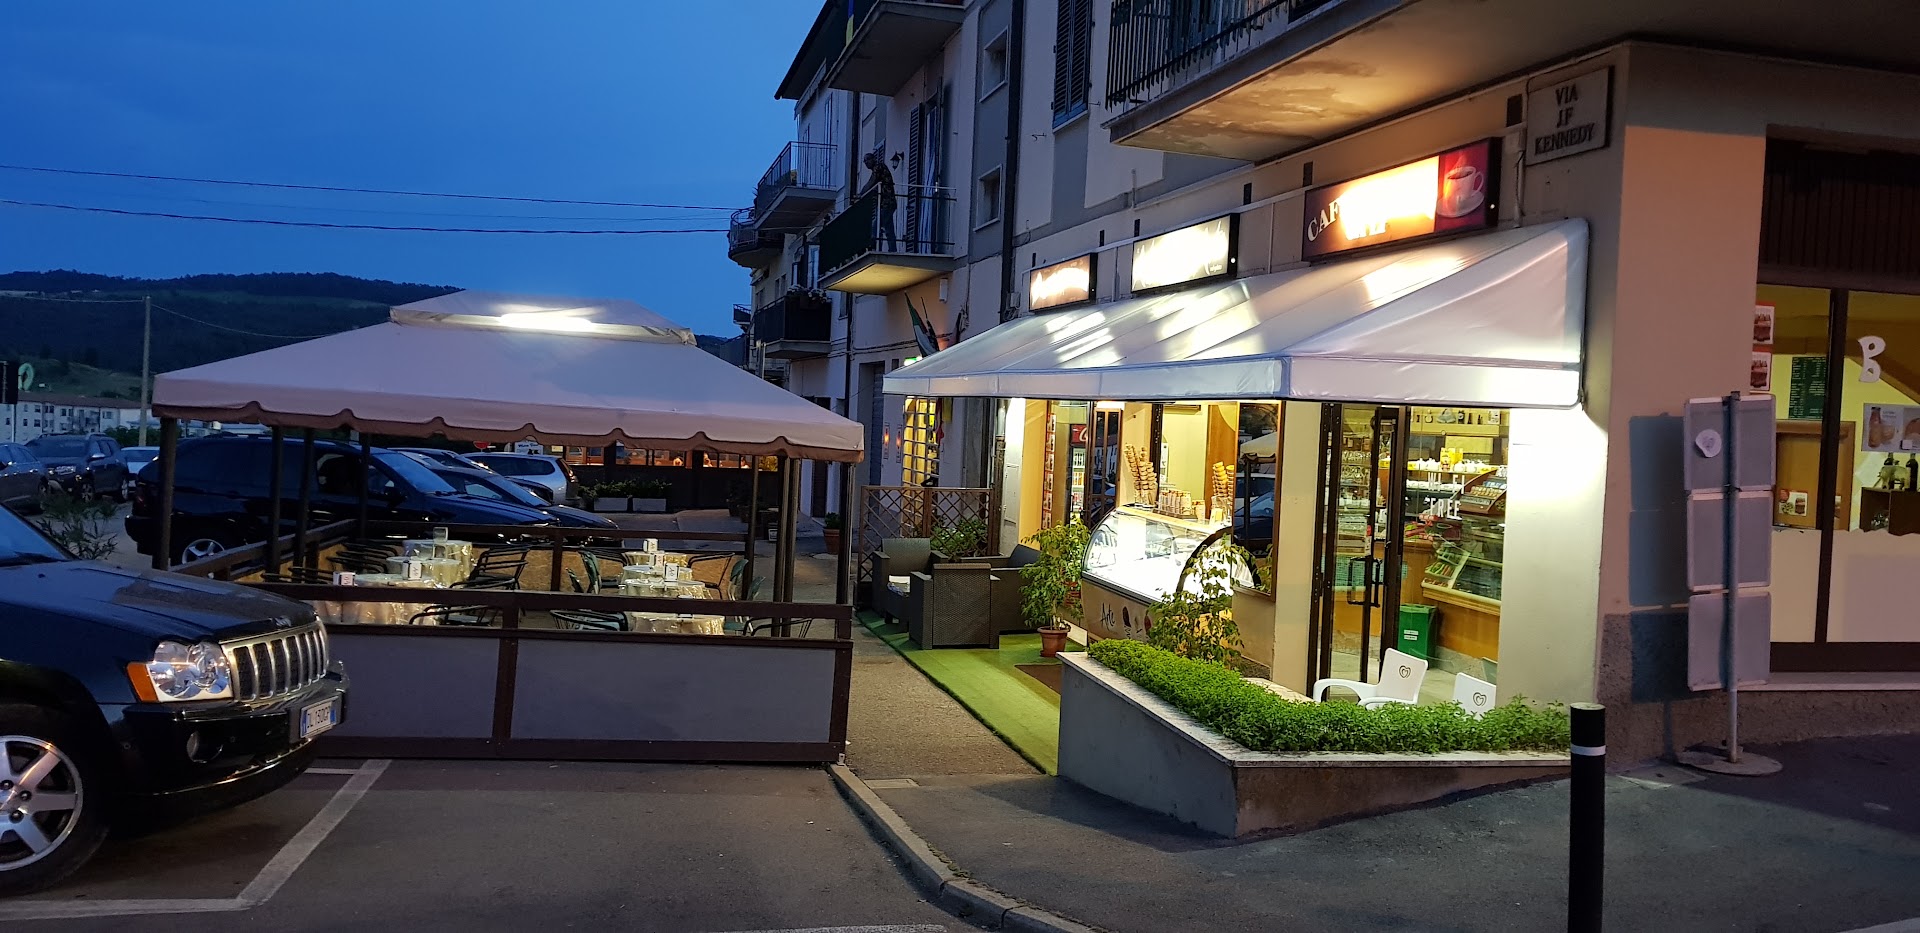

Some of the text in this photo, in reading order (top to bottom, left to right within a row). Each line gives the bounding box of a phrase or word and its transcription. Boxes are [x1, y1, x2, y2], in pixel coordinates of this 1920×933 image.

[1555, 84, 1578, 106] VIA
[1535, 123, 1595, 155] KENNEDY
[1857, 335, 1886, 383] B
[1430, 497, 1461, 519] FREE
